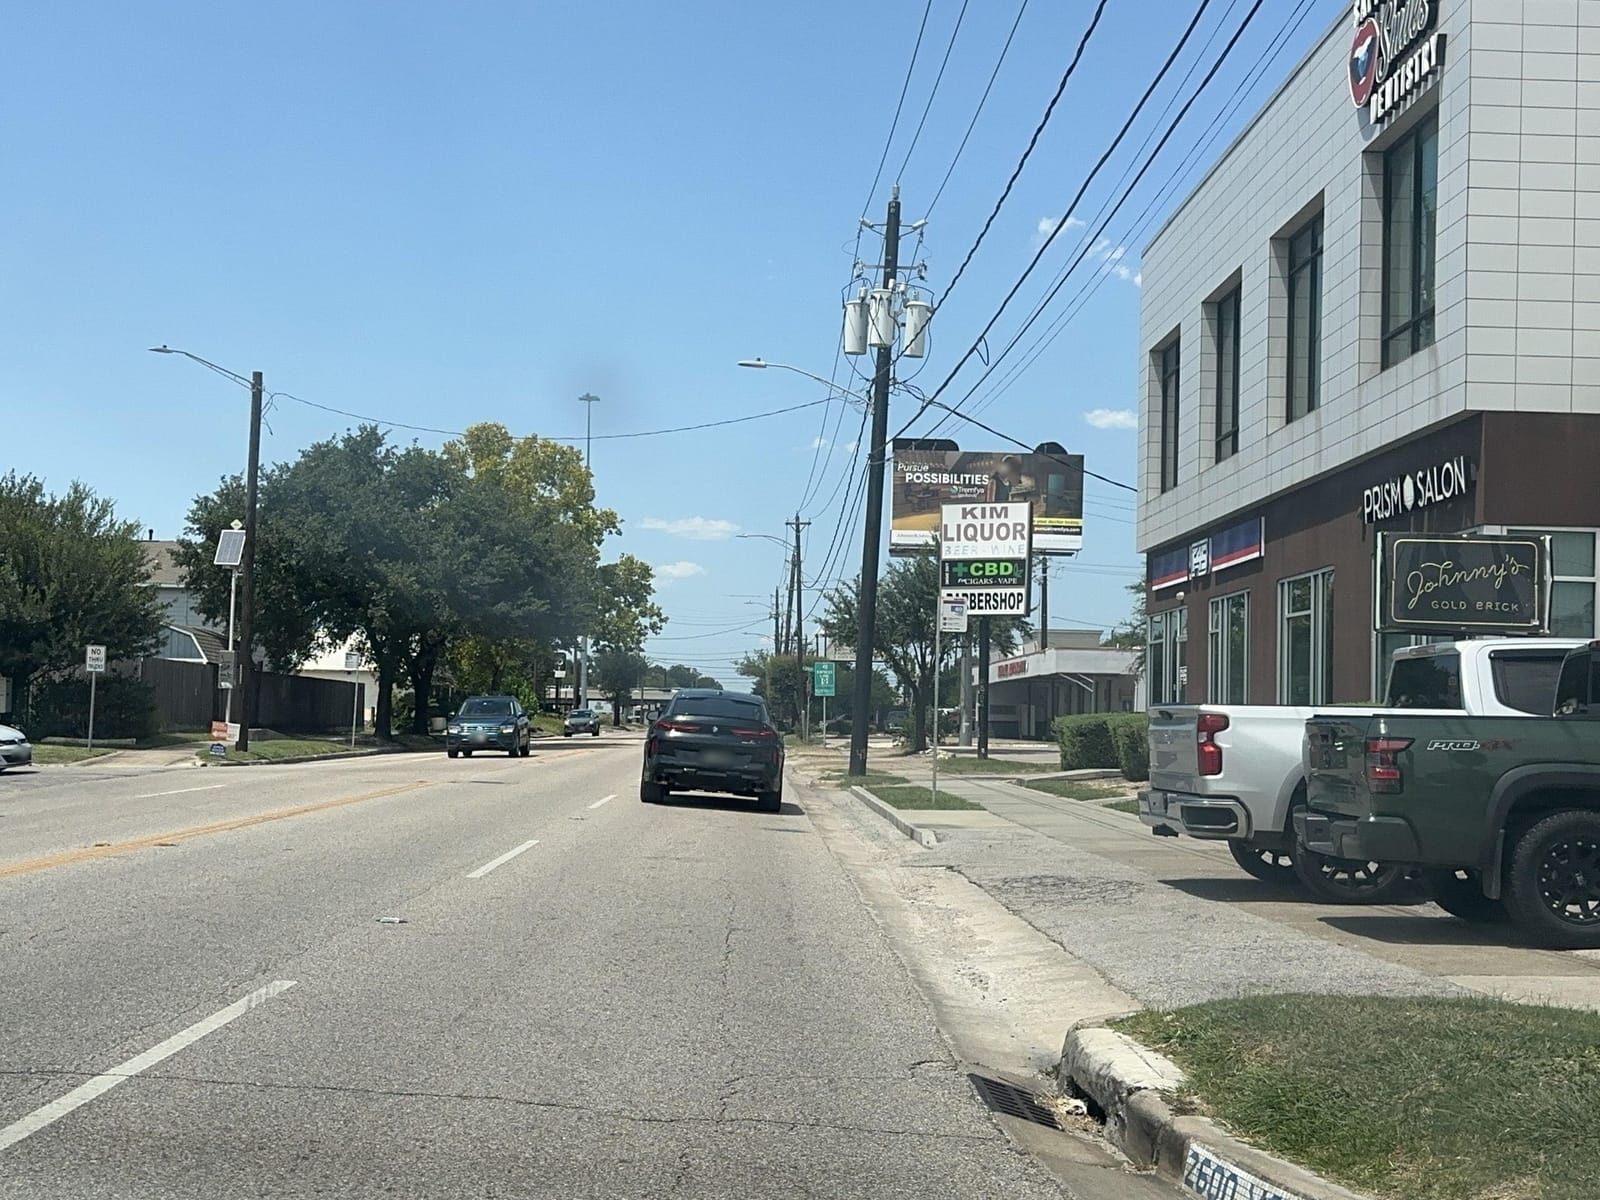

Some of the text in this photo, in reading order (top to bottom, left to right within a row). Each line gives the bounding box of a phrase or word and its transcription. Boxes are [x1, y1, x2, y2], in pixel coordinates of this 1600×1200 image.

[1370, 32, 1438, 124] DENTISTRY
[897, 462, 929, 472] Pursue
[905, 472, 990, 485] POSSIBILITIES
[1363, 455, 1466, 525] PRISM SALON
[961, 506, 1009, 520] KIM
[943, 522, 1026, 542] LIQUOR
[991, 544, 1025, 555] WINE
[969, 562, 1013, 576] CBD
[965, 577, 994, 585] CIGARS
[998, 577, 1018, 585] VAPE
[1407, 554, 1530, 610] Johnny's
[1431, 600, 1519, 612] GOLD BRICK
[1184, 1150, 1239, 1200] 2600
